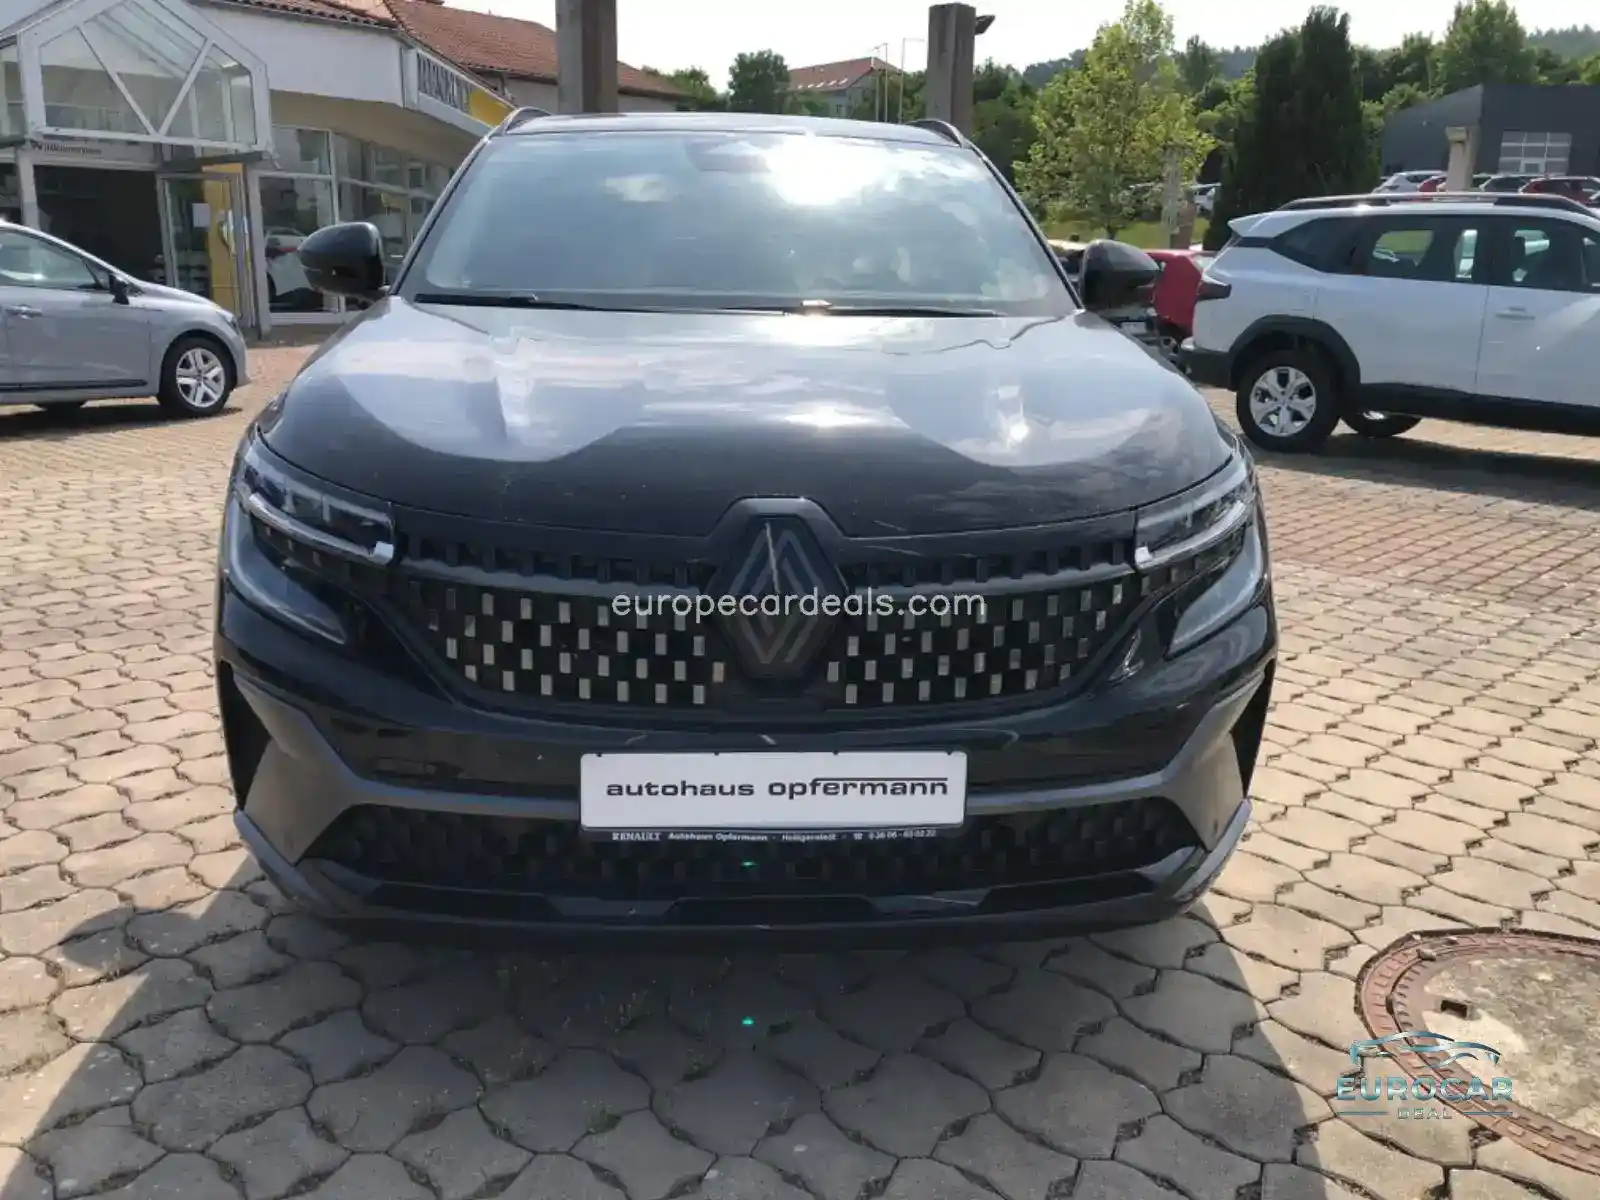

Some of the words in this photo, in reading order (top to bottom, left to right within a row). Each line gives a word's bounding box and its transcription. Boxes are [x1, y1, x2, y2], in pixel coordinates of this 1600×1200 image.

[606, 780, 754, 796] autohaus
[768, 777, 948, 800] opfermann
[612, 832, 661, 841] RENAULT
